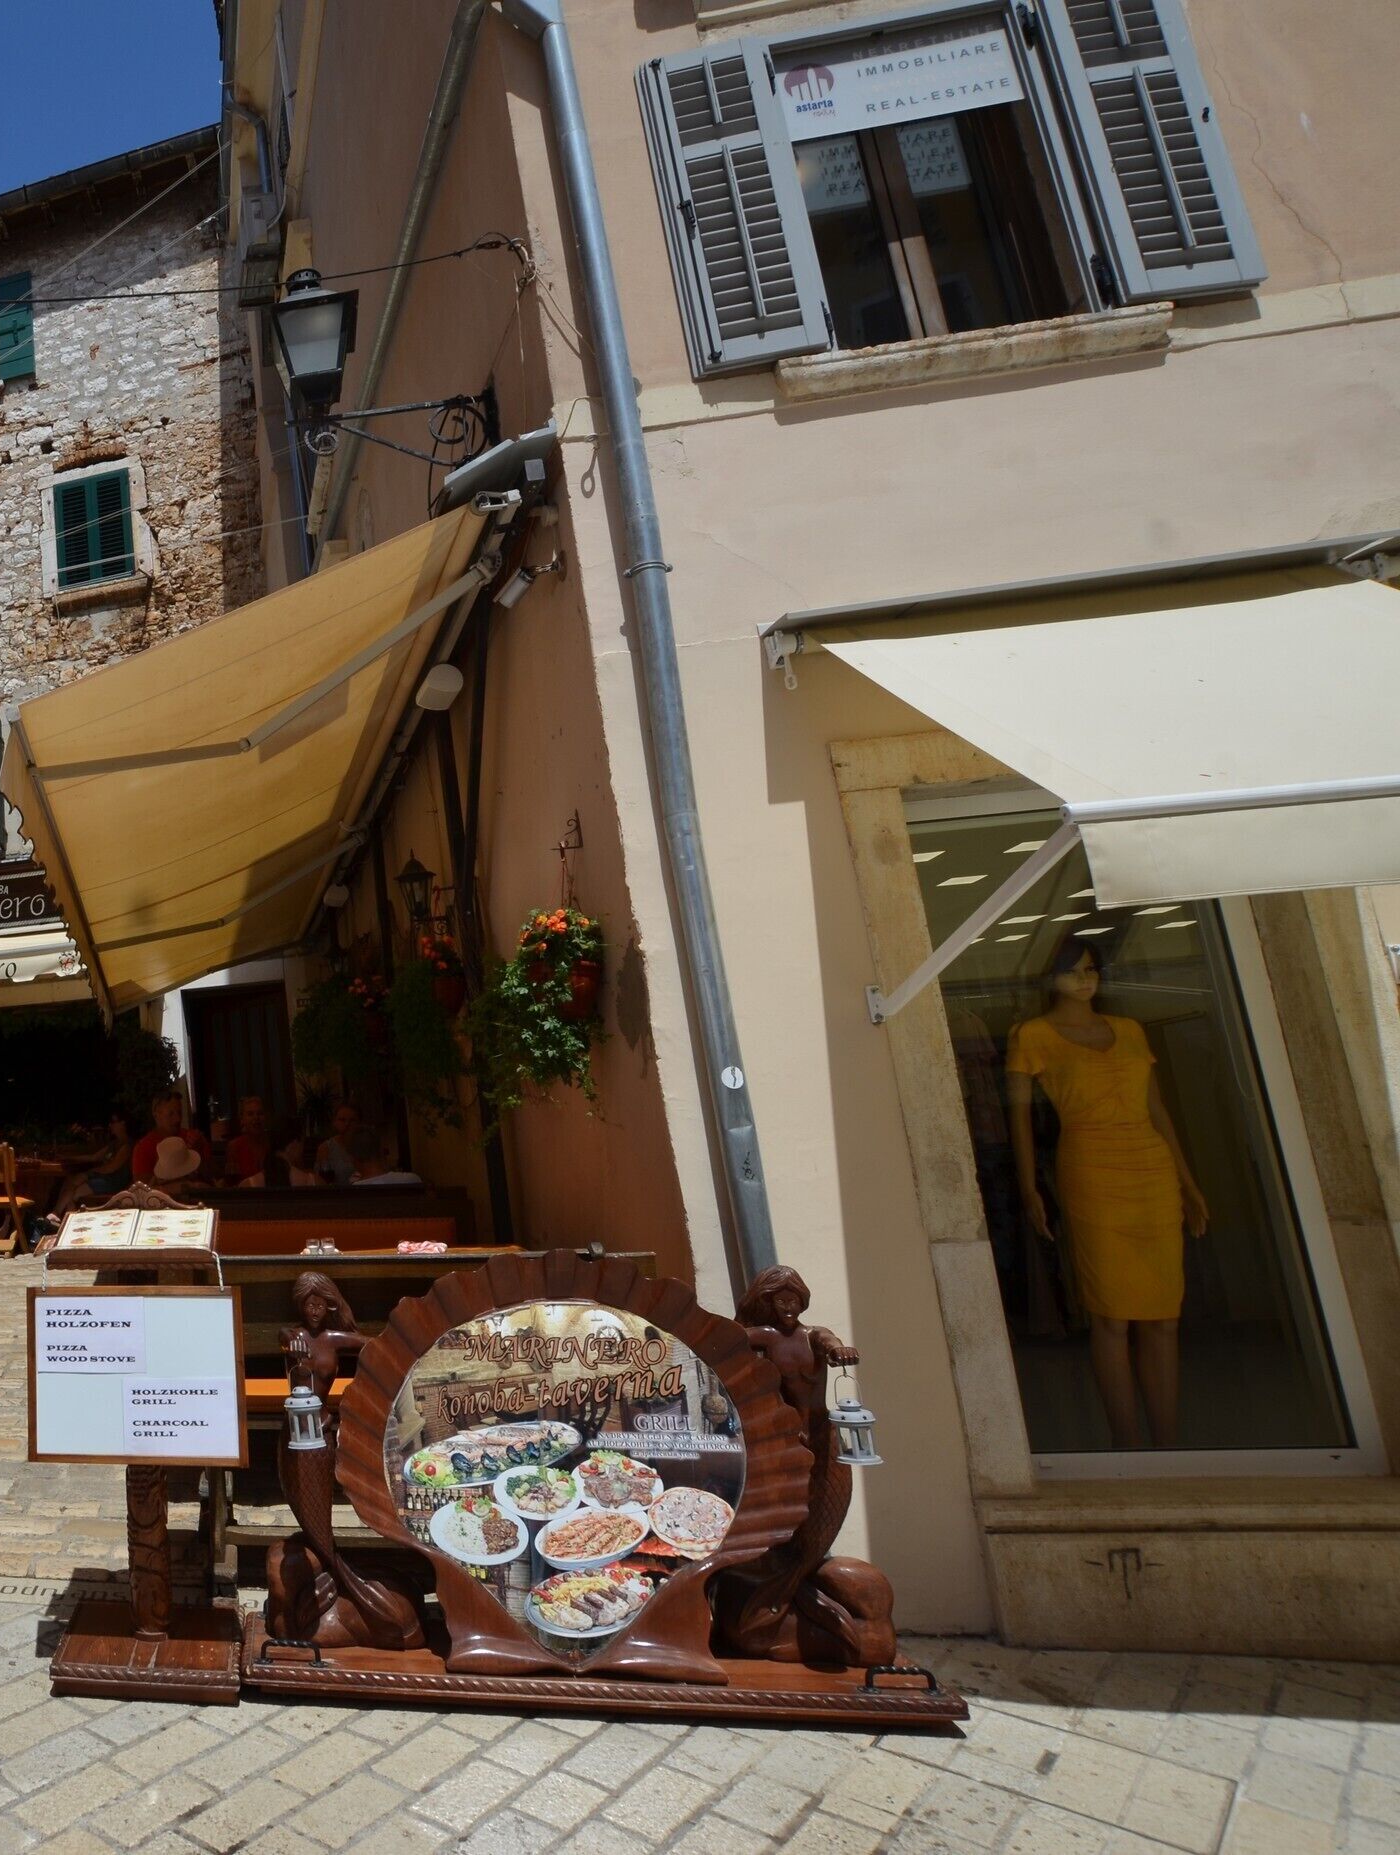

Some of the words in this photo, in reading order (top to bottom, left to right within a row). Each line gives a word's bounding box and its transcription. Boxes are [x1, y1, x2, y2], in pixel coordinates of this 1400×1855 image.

[852, 23, 995, 60] NEKRETNINE
[856, 41, 1001, 78] IMMOBILIARE
[796, 99, 834, 114] astarta
[865, 77, 1011, 113] REAL-ESTATE
[464, 1332, 667, 1370] MARINERO
[437, 1365, 686, 1424] konoba-taverna
[634, 1414, 698, 1432] GRILL
